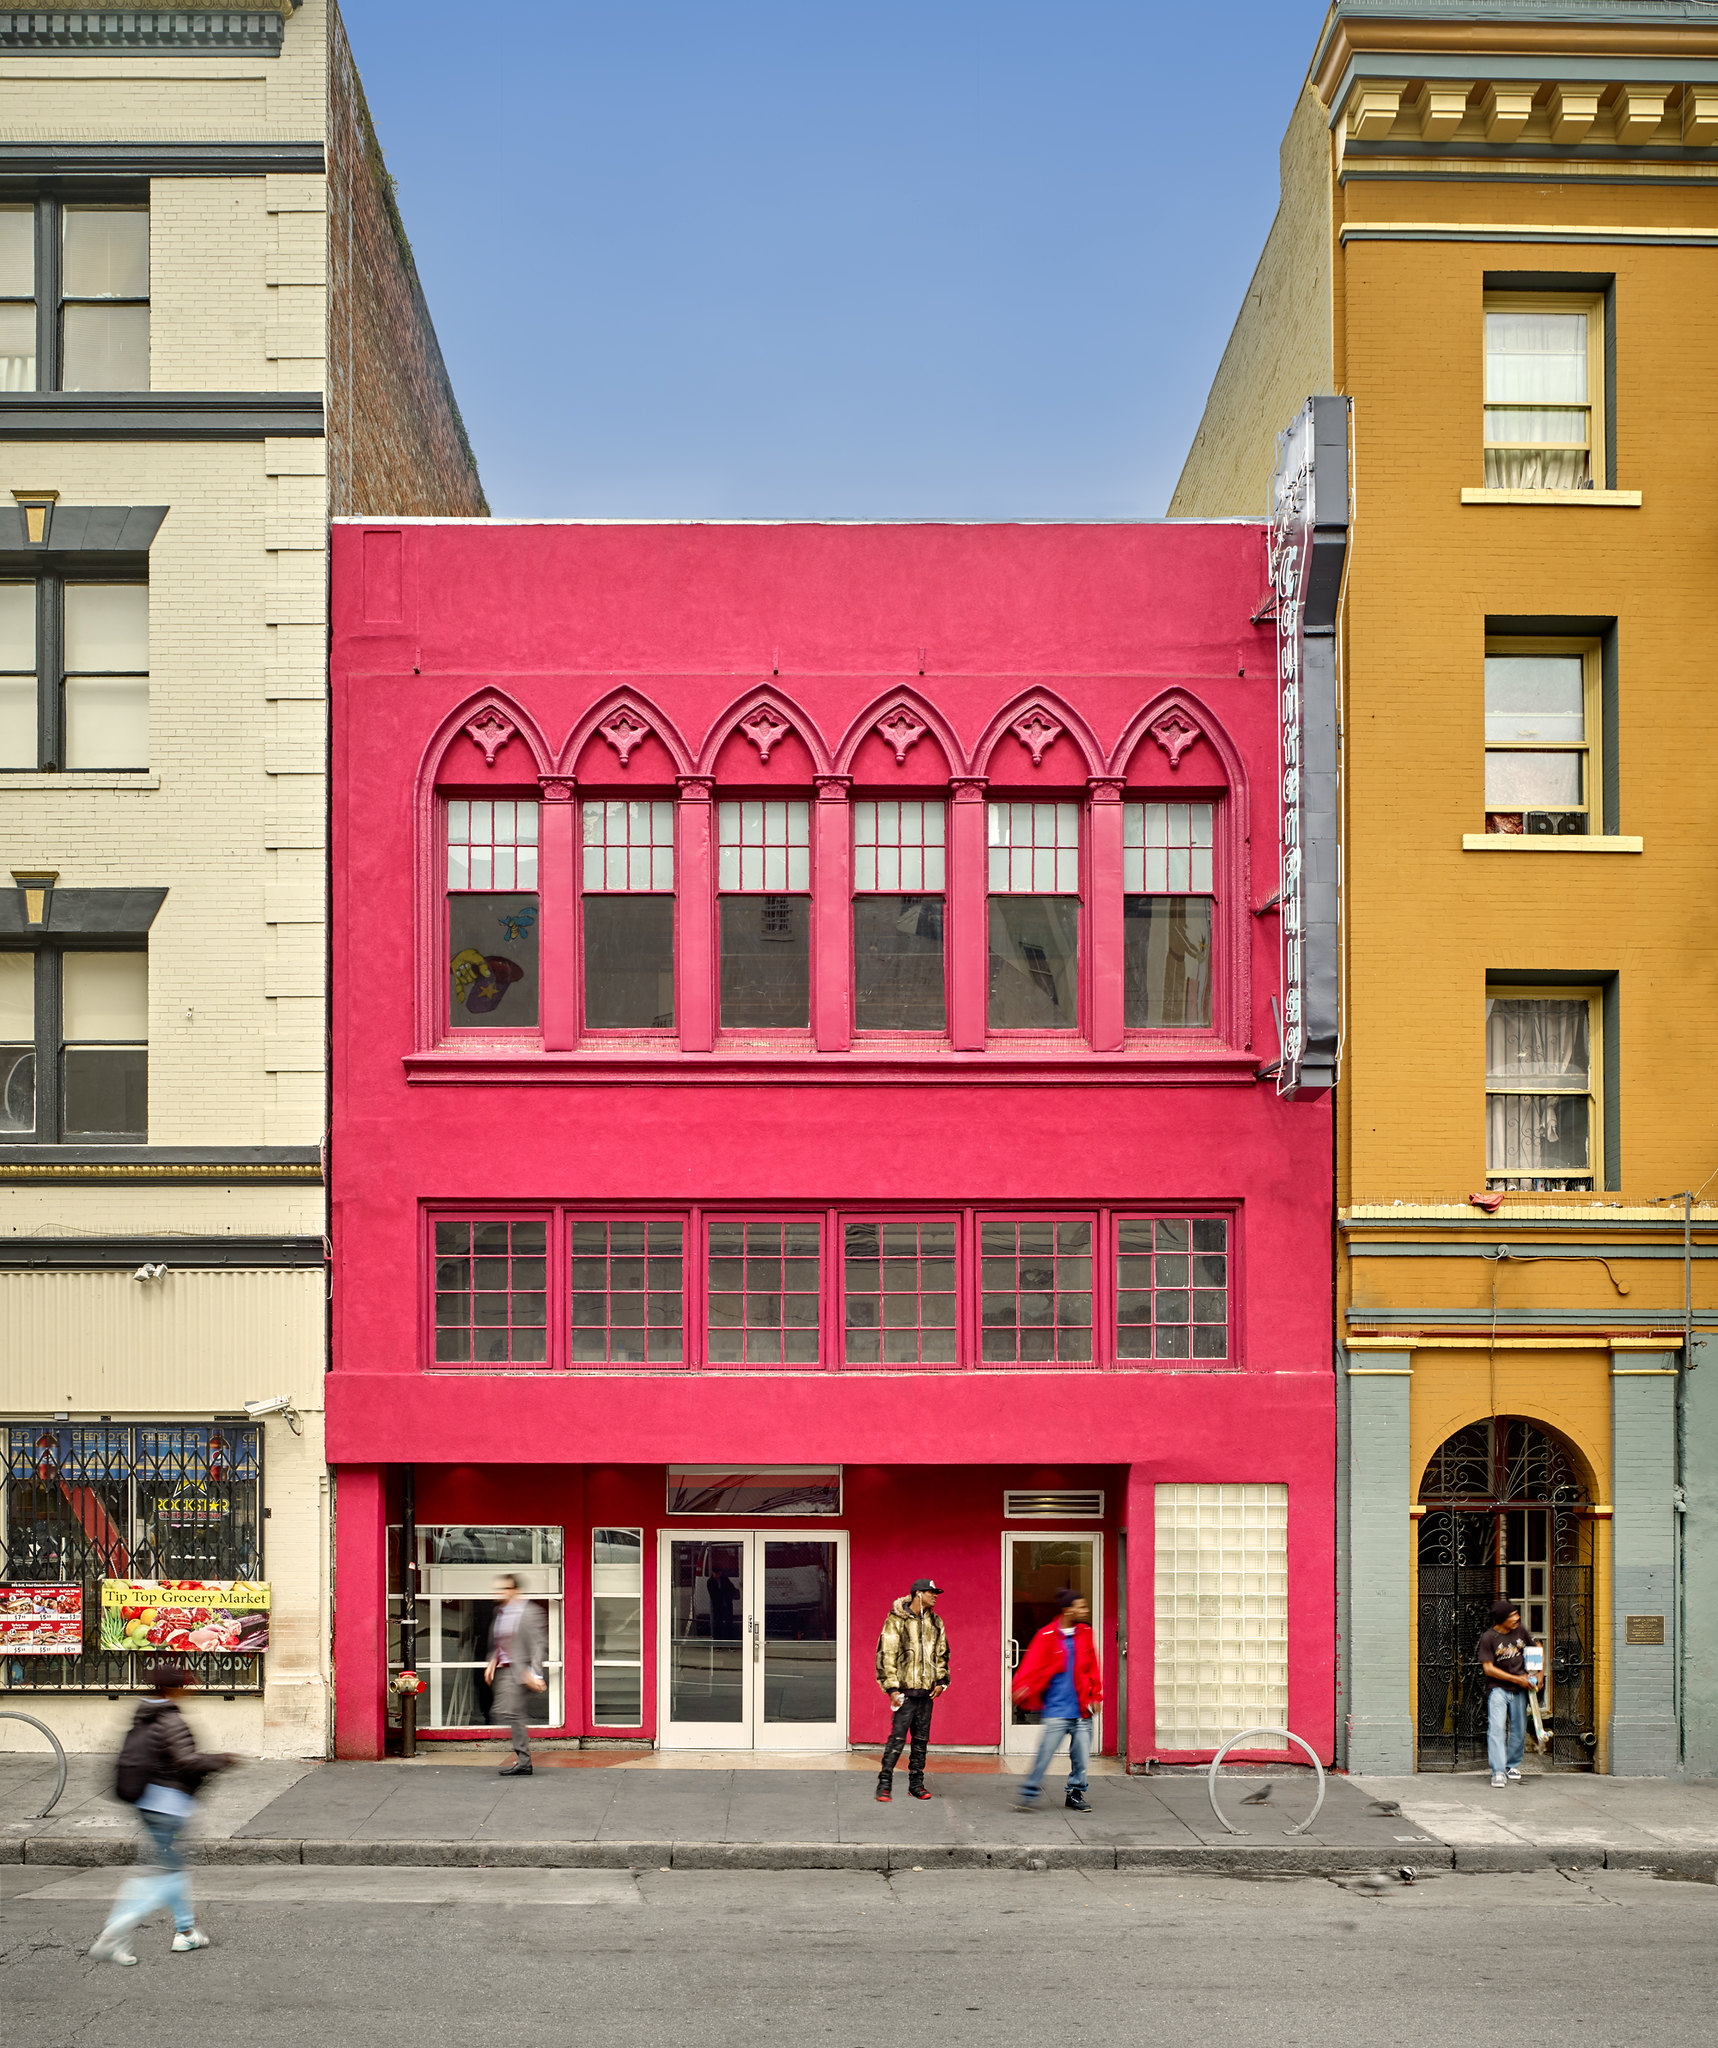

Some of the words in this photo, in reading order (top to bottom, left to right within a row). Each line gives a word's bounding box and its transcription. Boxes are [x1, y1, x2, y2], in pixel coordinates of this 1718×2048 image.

[141, 1432, 172, 1442] CHER
[105, 1591, 128, 1604] Tip
[131, 1592, 157, 1605] Top
[161, 1592, 216, 1606] Grocery
[219, 1593, 267, 1604] Market
